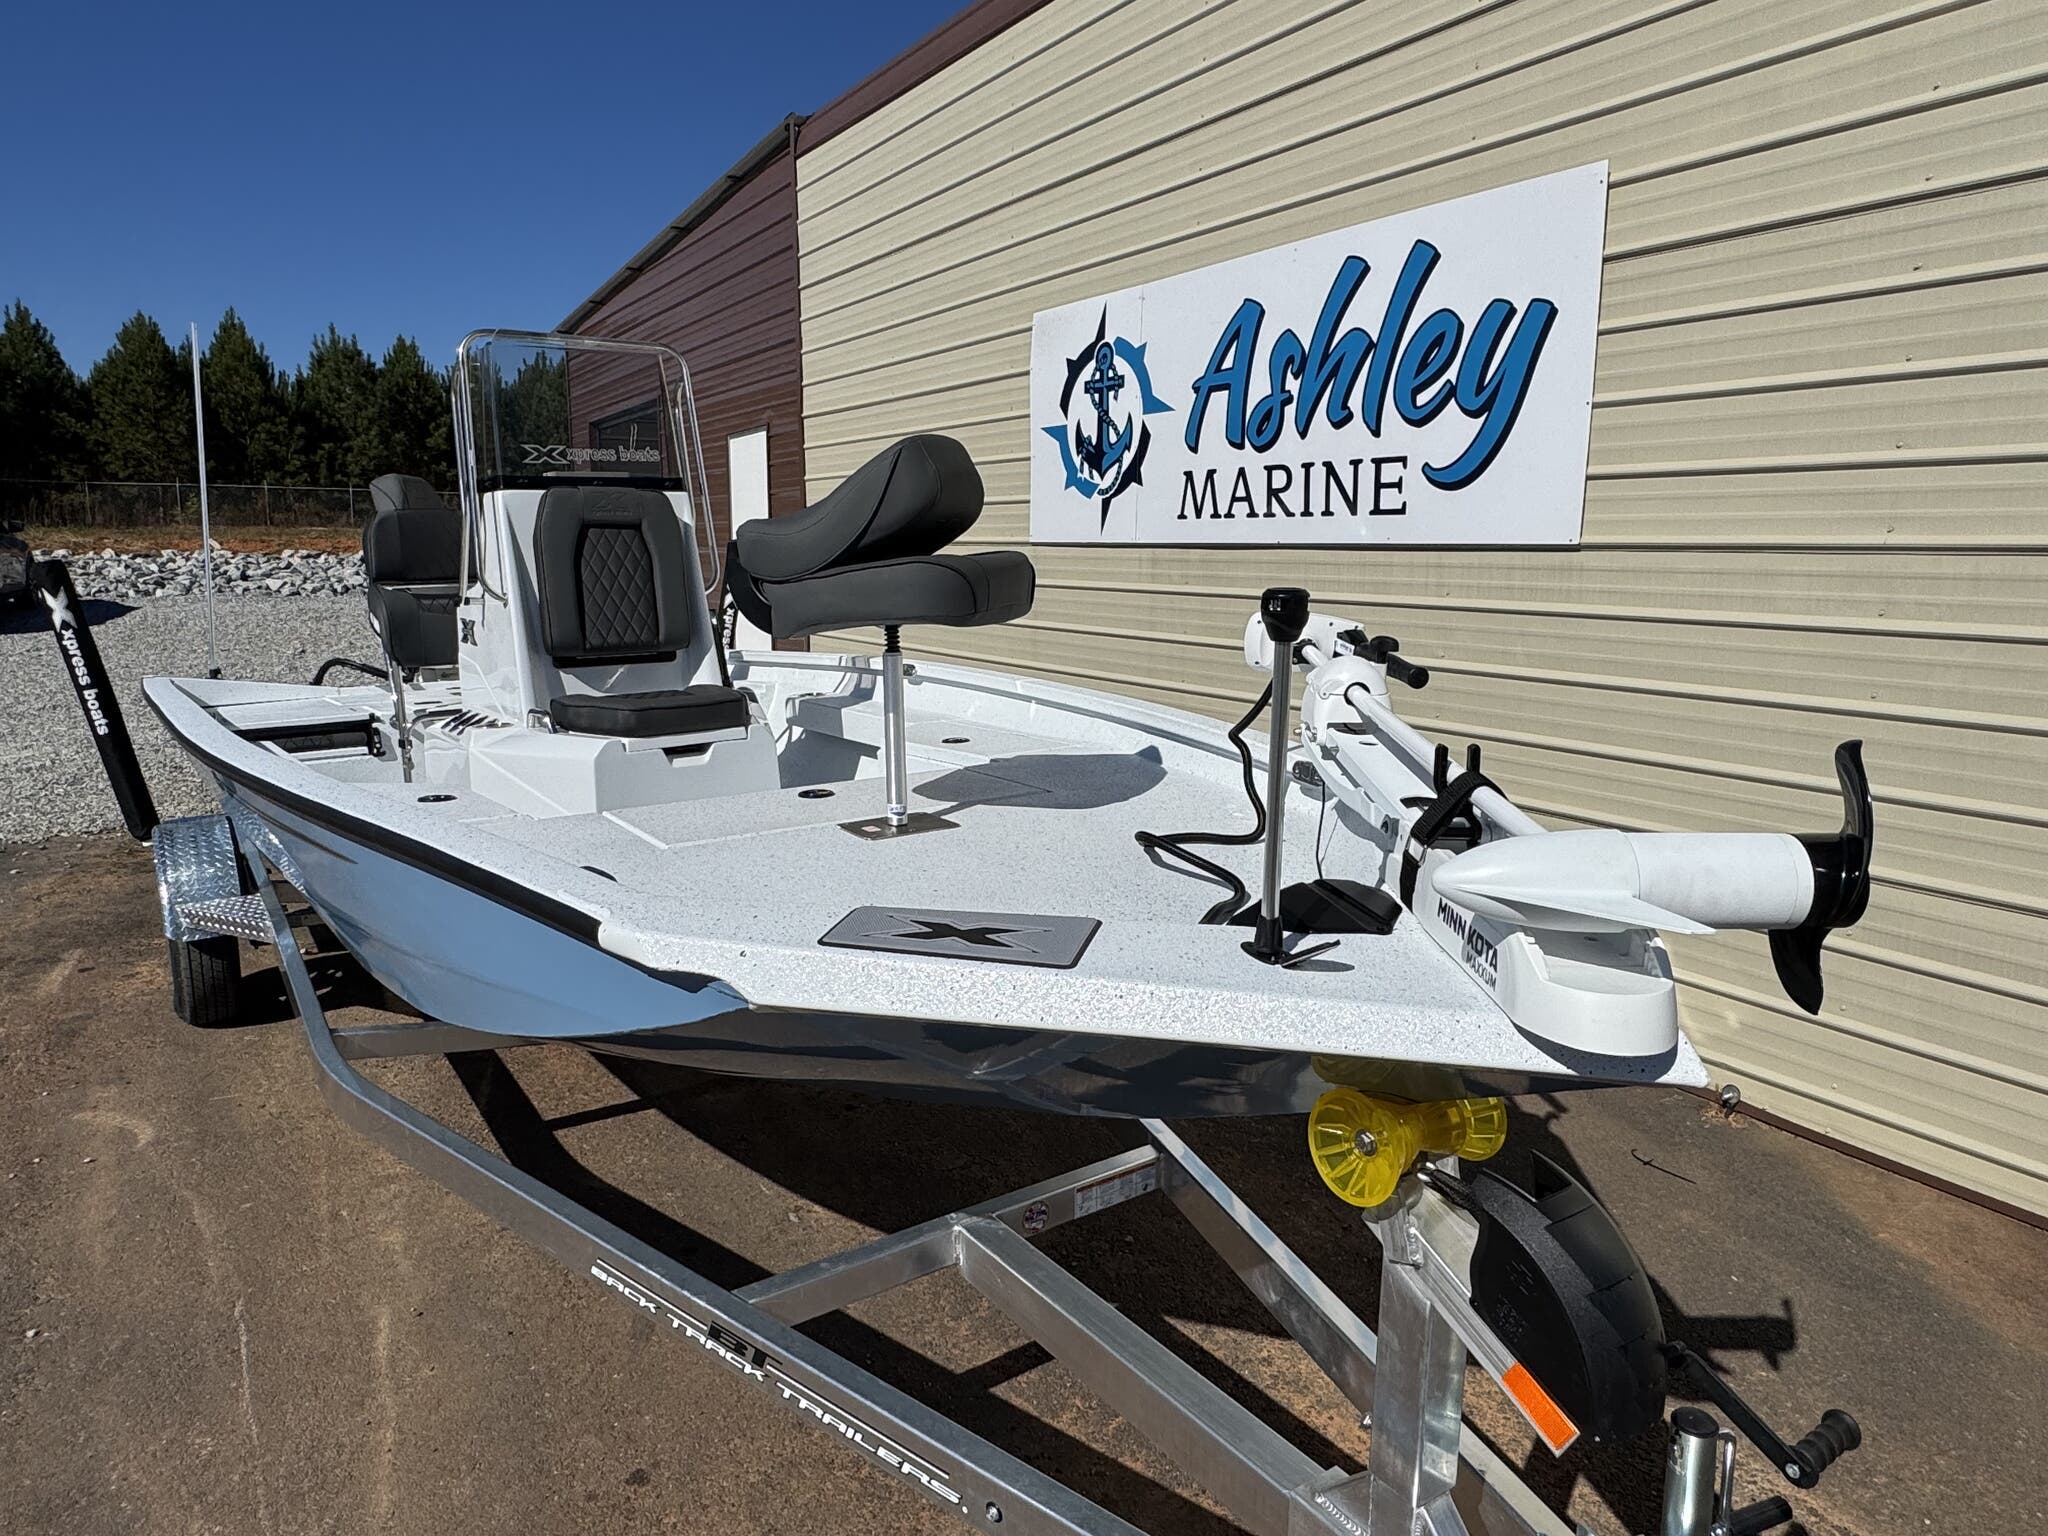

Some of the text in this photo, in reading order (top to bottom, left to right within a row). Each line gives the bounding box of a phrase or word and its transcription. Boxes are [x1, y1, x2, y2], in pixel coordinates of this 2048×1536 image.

[1184, 238, 1559, 491] Ashley
[566, 447, 617, 464] xpress
[618, 445, 661, 462] boats
[1177, 455, 1408, 521] MARINE
[60, 628, 91, 686] xpress
[83, 688, 109, 736] boats
[1437, 897, 1498, 973] MINN KOTA
[1465, 951, 1497, 992] MAXXUM
[591, 1265, 656, 1314] BACK
[667, 1313, 766, 1382] TRACK
